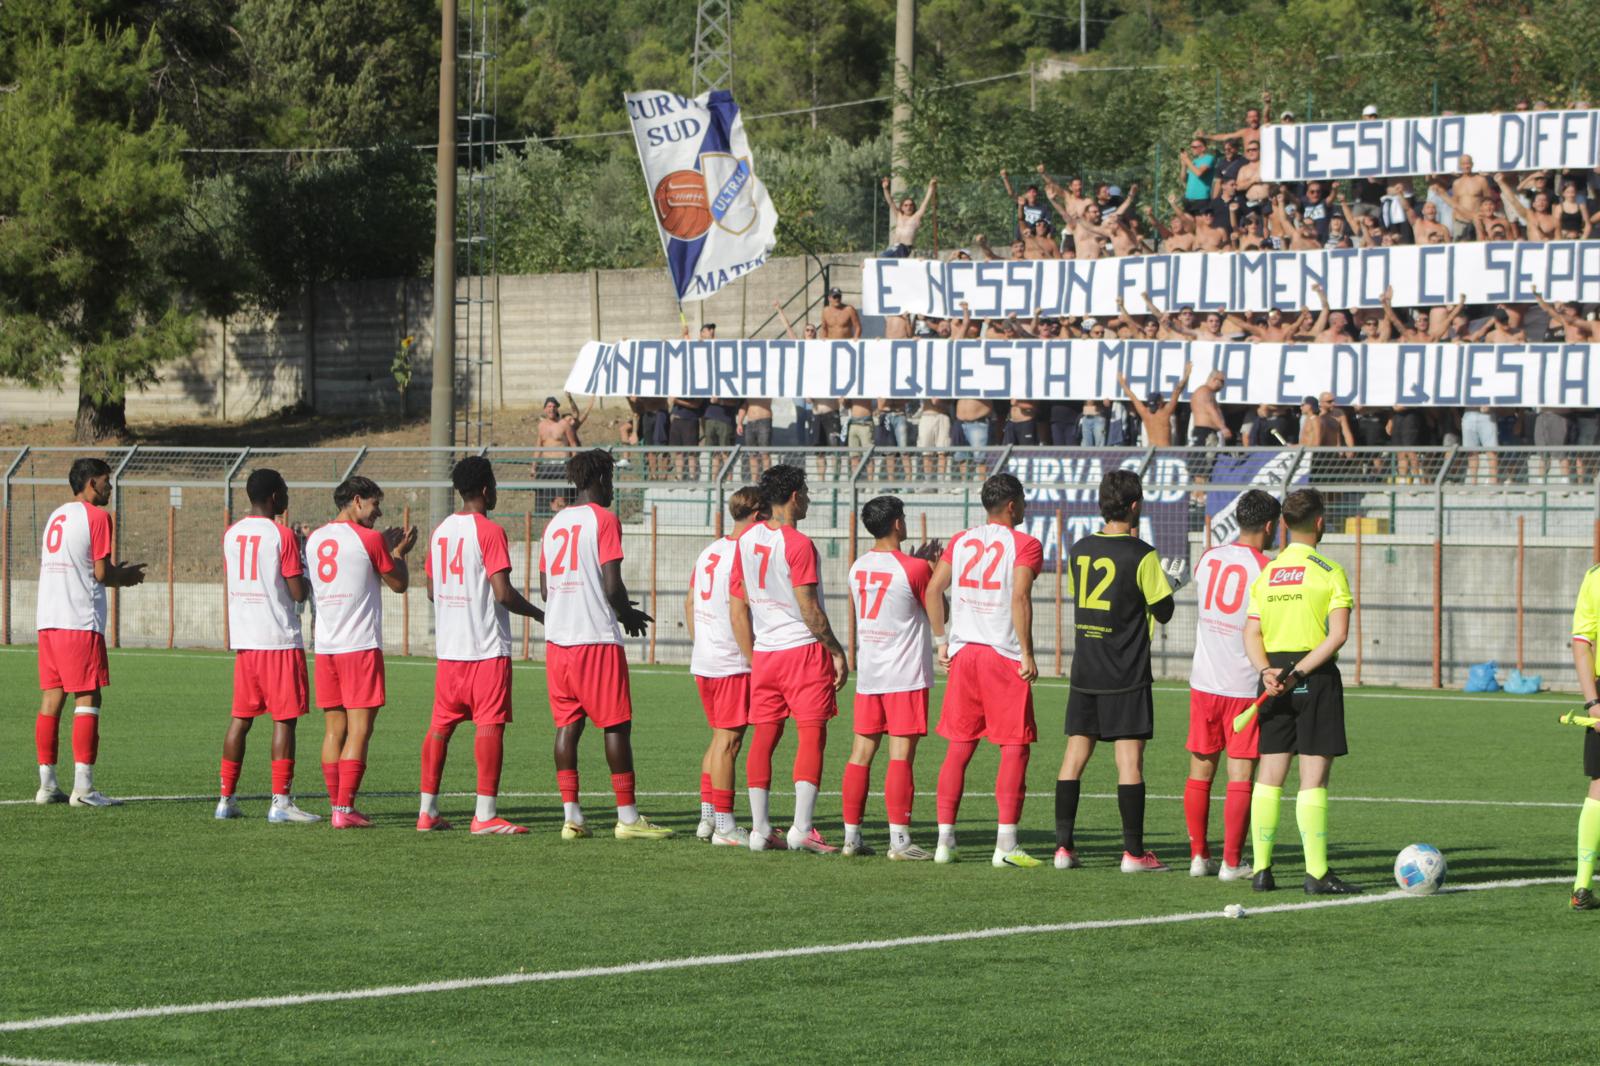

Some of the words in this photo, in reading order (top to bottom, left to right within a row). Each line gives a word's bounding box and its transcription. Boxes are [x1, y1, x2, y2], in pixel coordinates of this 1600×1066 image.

[628, 93, 700, 120] CURV
[647, 118, 701, 147] SUD
[1275, 116, 1465, 179] NESSUNA
[876, 260, 901, 314] E
[926, 260, 1097, 317] NESSUN
[1118, 249, 1391, 314] FALLIMENTO
[1418, 245, 1455, 303] CI
[584, 341, 806, 397] INNAMORATI
[830, 342, 865, 397] DI
[890, 341, 1072, 399] QUESTA
[1096, 341, 1252, 401] MAGLIA
[1277, 344, 1308, 403] E
[1332, 344, 1368, 405] DI
[1398, 344, 1591, 405] QUESTA
[46, 514, 67, 554] 6
[236, 535, 262, 581] 11
[551, 525, 582, 577] 21
[317, 539, 339, 584] 8
[438, 537, 464, 585] 14
[700, 553, 721, 601] 3
[753, 543, 772, 589] 7
[958, 538, 1004, 590] 22
[1076, 555, 1116, 611] 12
[1270, 568, 1304, 584] Lete
[855, 570, 893, 620] 17
[1203, 558, 1248, 615] 10
[1267, 594, 1303, 603] GIVOVA
